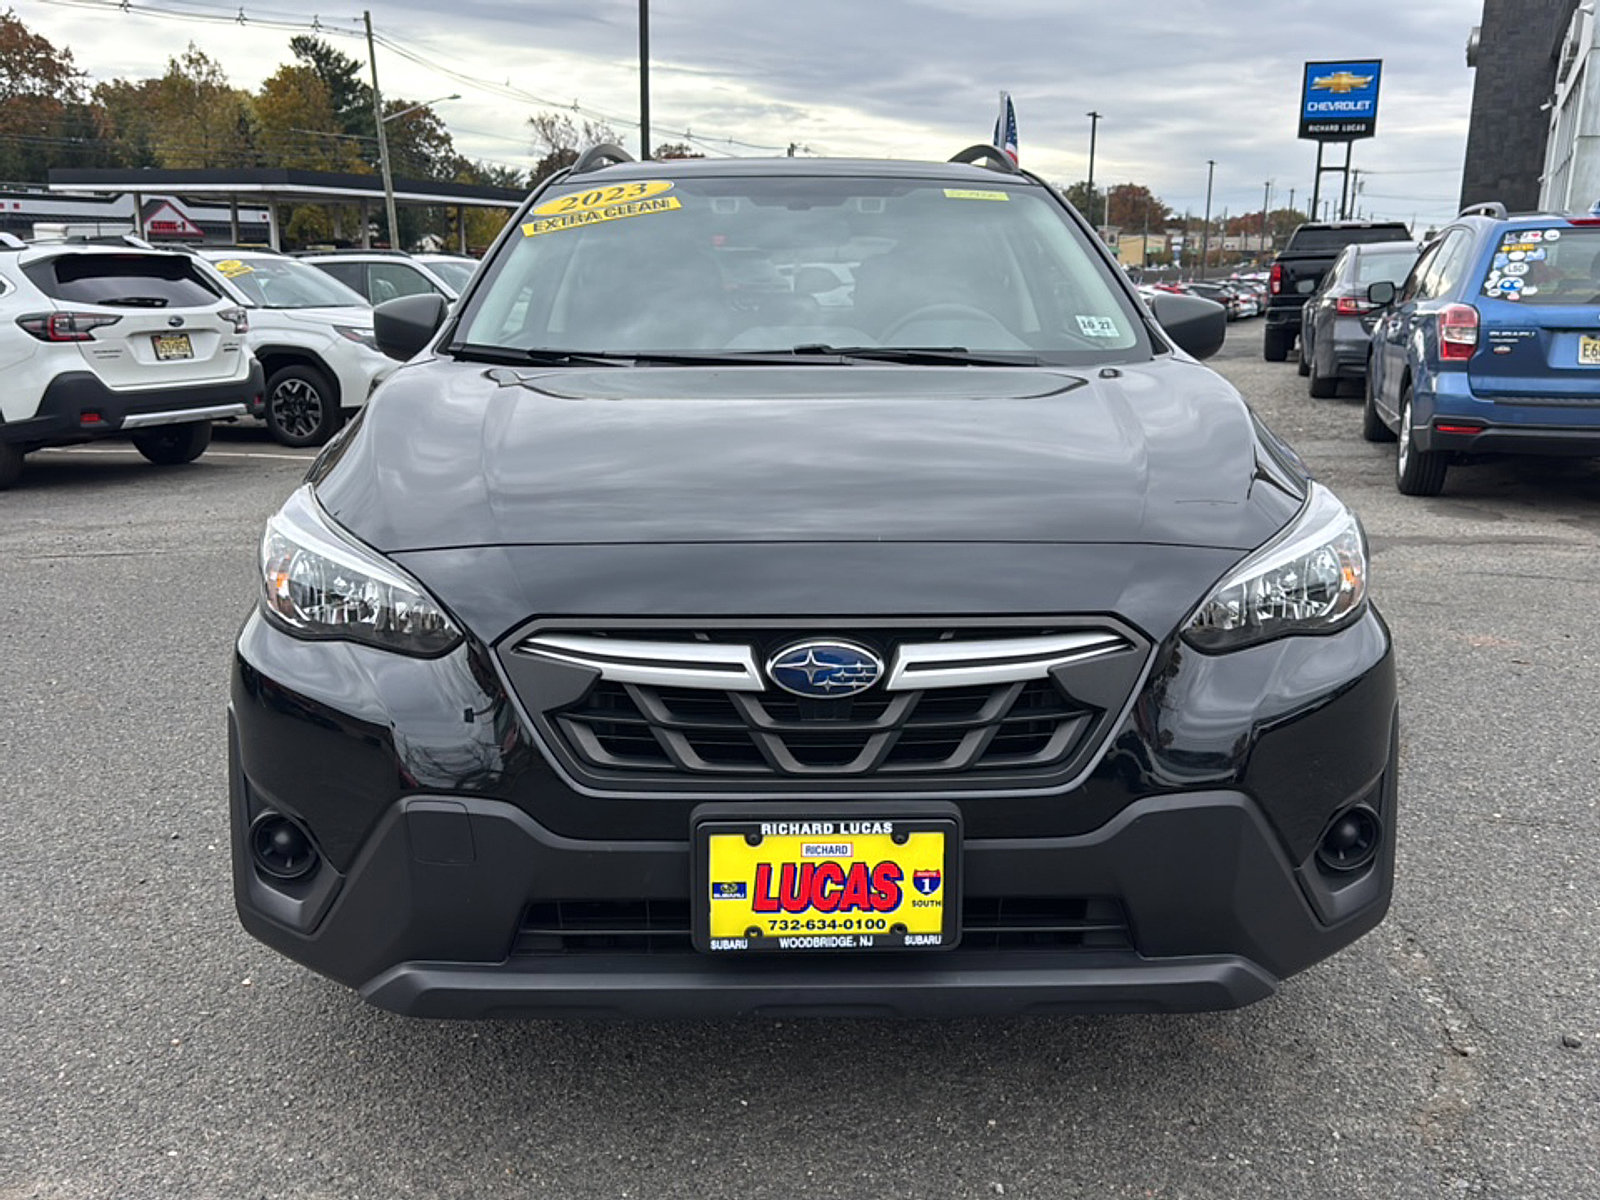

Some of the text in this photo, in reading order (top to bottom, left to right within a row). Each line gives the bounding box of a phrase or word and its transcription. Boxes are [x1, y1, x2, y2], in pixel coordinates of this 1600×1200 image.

[1307, 101, 1370, 111] CHEVROLET
[1342, 123, 1366, 132] LUCAS
[558, 183, 648, 212] 2023
[533, 212, 599, 232] EXTRA
[761, 822, 893, 835] RICHARD LUCAS
[804, 845, 848, 855] RICHARD
[752, 860, 904, 914] LUCAS
[921, 878, 932, 893] 1
[912, 900, 942, 908] SOUTH
[768, 919, 886, 931] 732-634-0100
[710, 938, 748, 950] SUBARU
[860, 935, 874, 946] NJ
[904, 934, 942, 945] SUBARU
